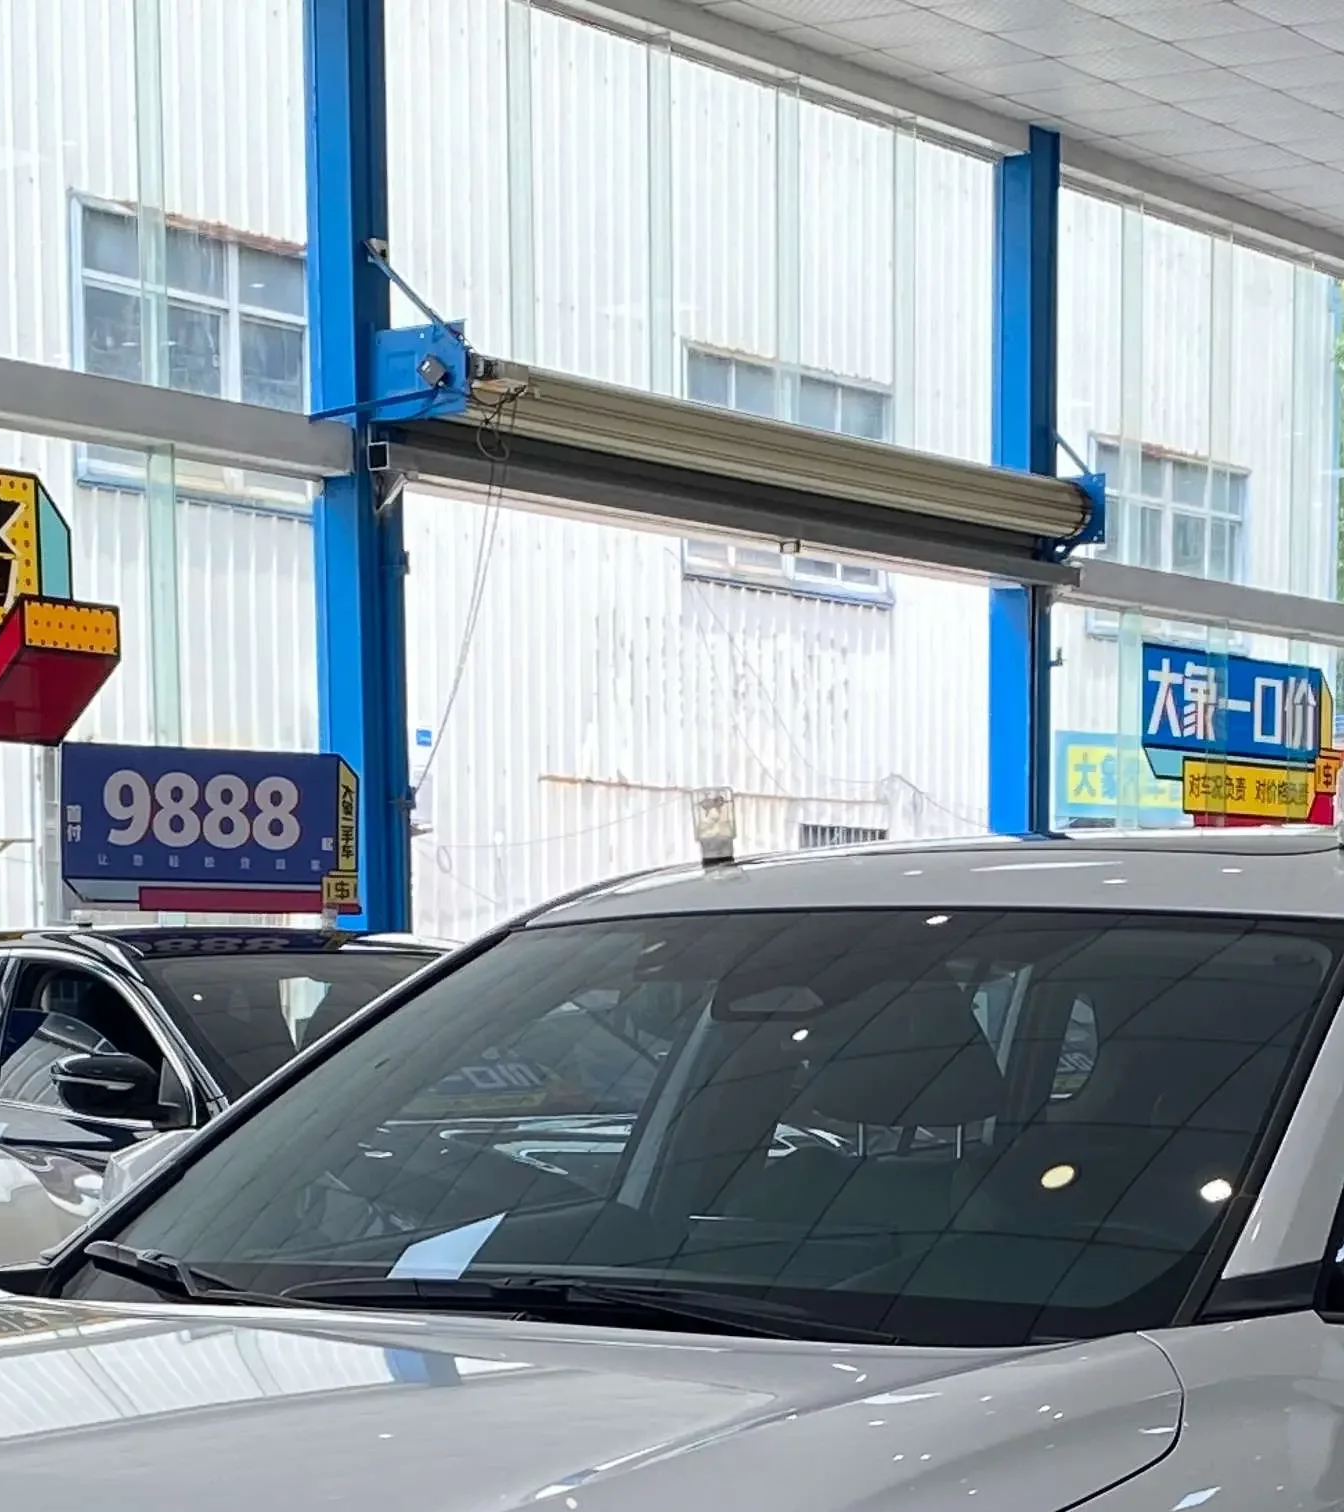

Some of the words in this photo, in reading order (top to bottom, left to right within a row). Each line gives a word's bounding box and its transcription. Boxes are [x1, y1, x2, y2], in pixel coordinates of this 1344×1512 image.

[1147, 658, 1319, 751] 大象一口价
[103, 769, 301, 850] 9888
